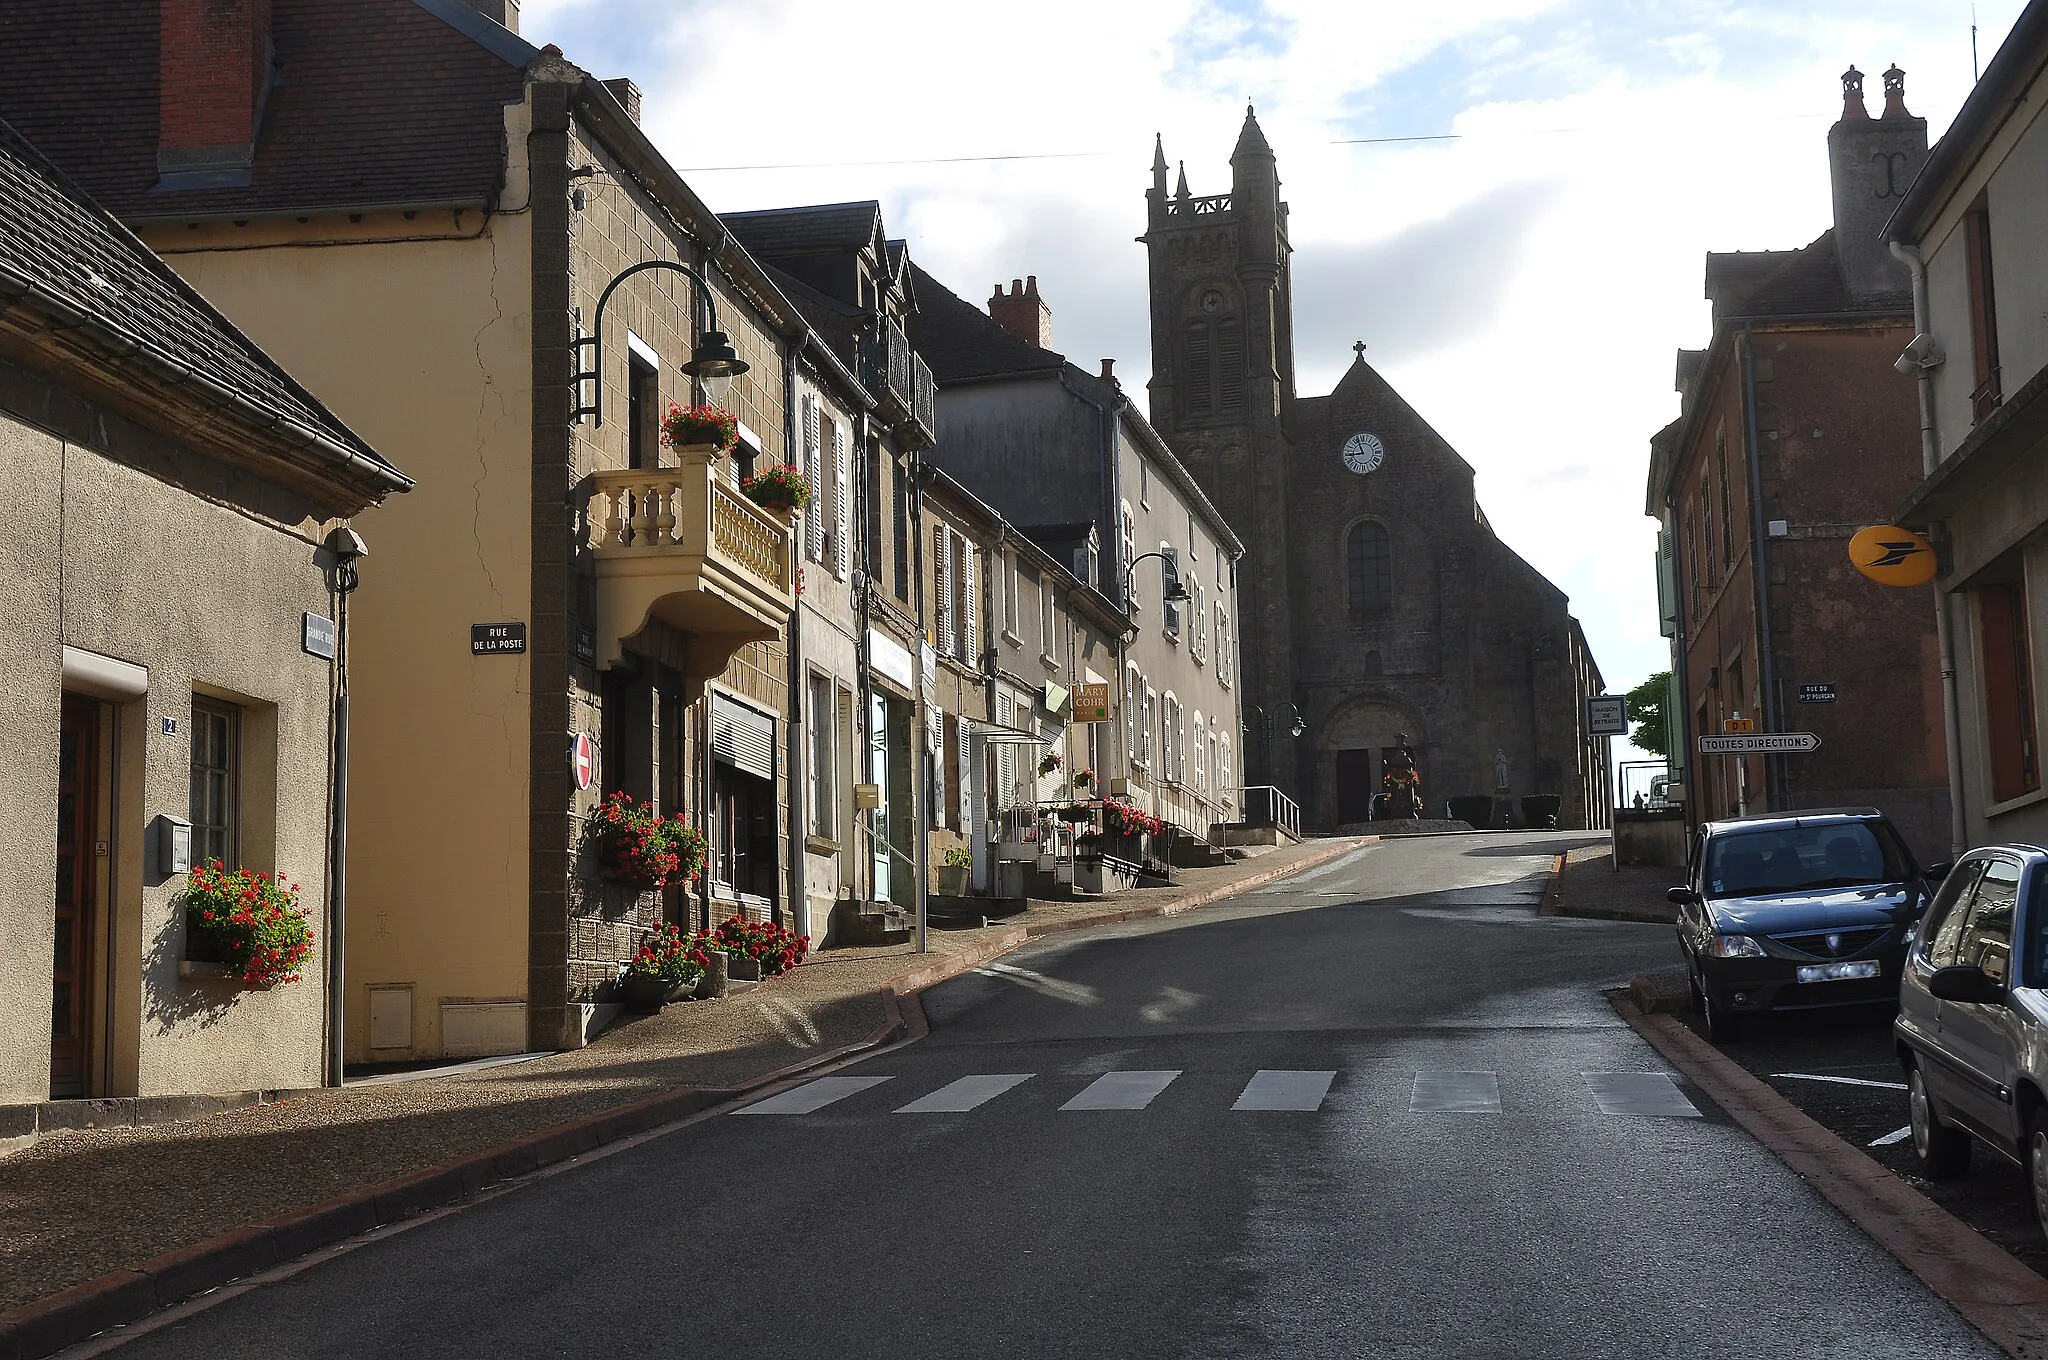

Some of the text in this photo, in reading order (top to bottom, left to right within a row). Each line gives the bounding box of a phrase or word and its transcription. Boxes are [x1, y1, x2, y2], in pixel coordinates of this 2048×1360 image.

[308, 626, 324, 642] GRANDE
[489, 627, 508, 637] RUE
[474, 639, 523, 650] DE LA POSTE
[1076, 687, 1105, 697] MARY
[1075, 698, 1105, 707] COHR
[167, 719, 173, 732] 2
[1705, 737, 1809, 749] TOUTES DIRECTIONS
